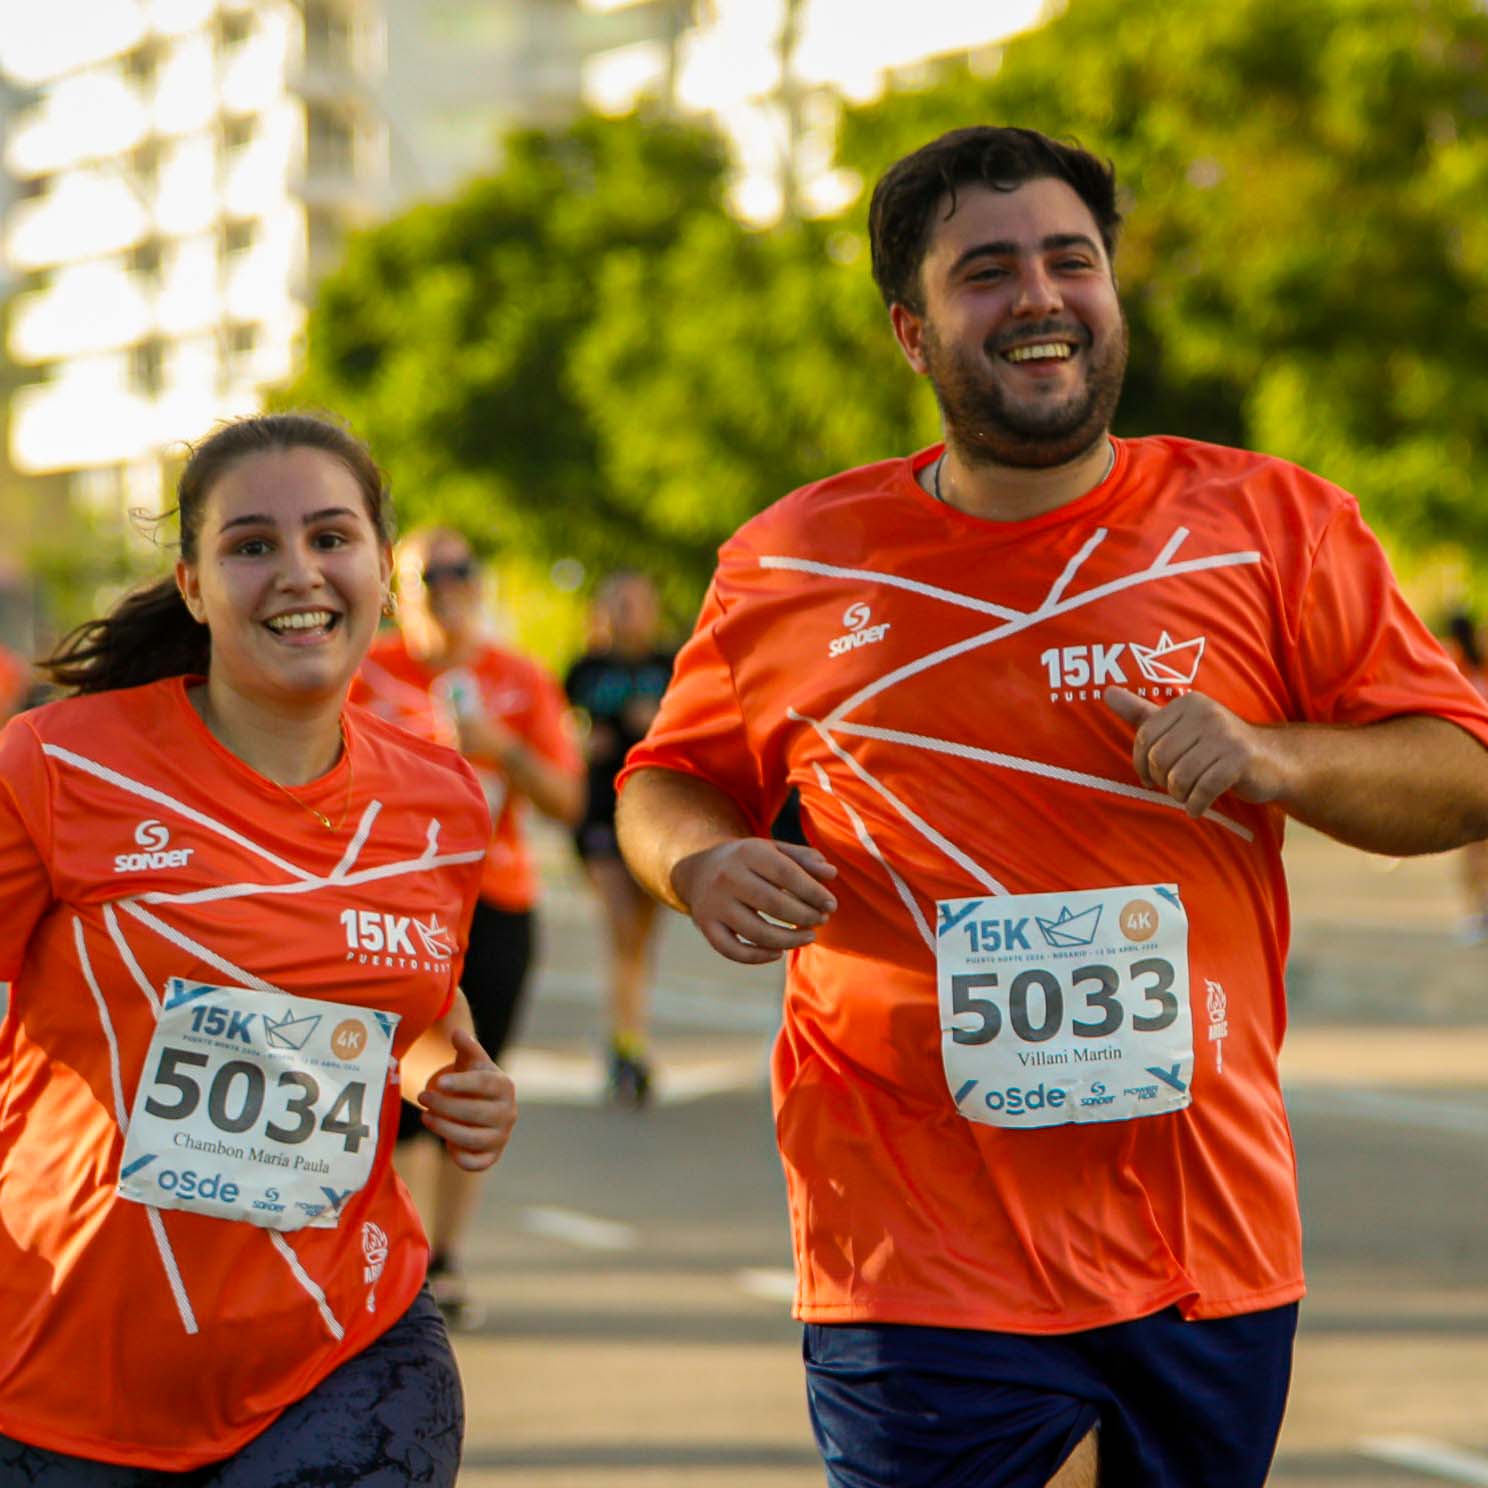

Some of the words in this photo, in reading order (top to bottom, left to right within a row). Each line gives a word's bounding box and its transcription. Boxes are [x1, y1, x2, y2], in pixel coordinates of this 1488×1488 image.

[1040, 643, 1129, 689] 15K
[340, 908, 417, 956] 15K
[964, 917, 1031, 952] 15K
[1127, 911, 1152, 930] 4K
[346, 952, 418, 969] PUERTO
[951, 958, 1179, 1046] 5033
[191, 1005, 257, 1044] 15K
[336, 1030, 361, 1049] 4K
[1017, 1049, 1068, 1067] Villani
[144, 1046, 370, 1154] 5034
[985, 1083, 1067, 1116] osde
[174, 1132, 244, 1159] Chambon
[294, 1155, 330, 1174] Paula
[158, 1169, 240, 1203] osde
